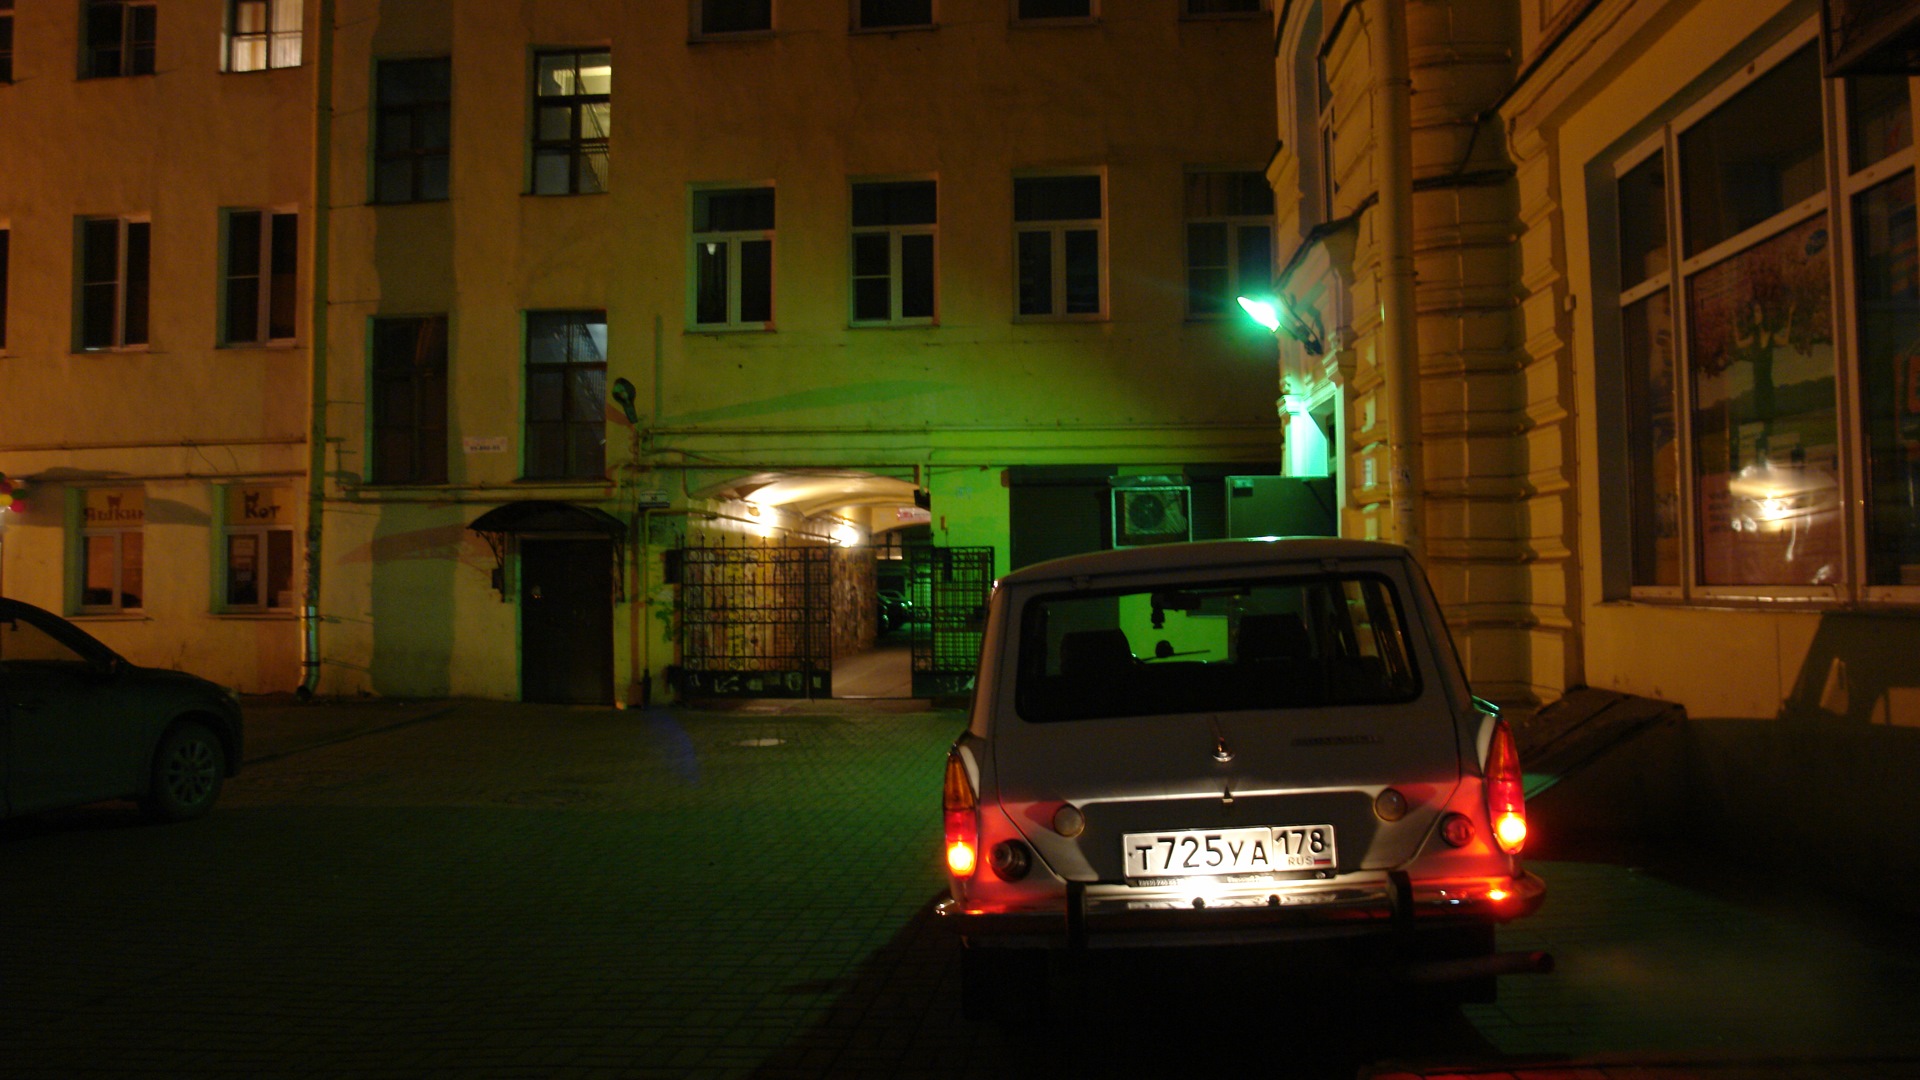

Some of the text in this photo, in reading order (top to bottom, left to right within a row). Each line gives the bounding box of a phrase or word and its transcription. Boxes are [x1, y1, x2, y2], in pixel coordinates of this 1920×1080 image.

[245, 503, 280, 519] Кот
[1275, 828, 1328, 856] 178
[1288, 855, 1314, 866] RUS
